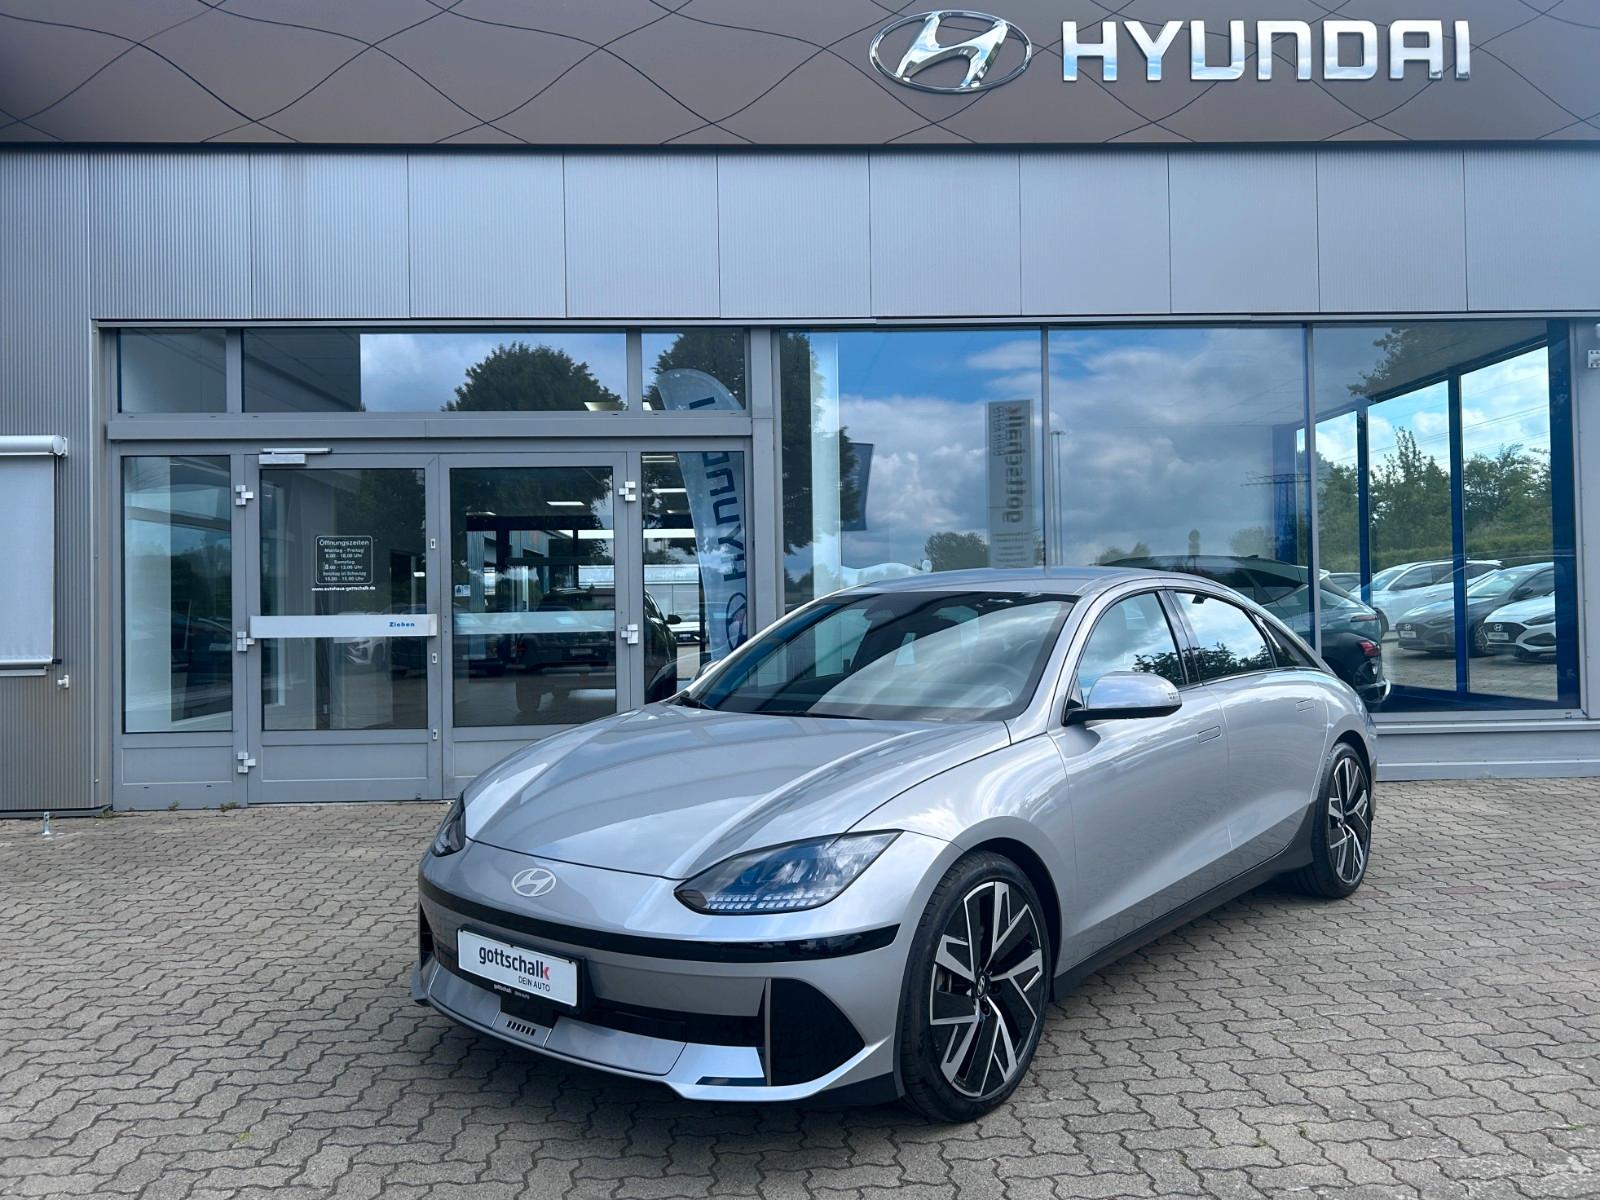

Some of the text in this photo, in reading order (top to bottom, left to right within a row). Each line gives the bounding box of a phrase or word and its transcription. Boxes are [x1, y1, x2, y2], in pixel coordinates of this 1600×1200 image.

[1062, 19, 1471, 81] HYUNDAI
[319, 539, 370, 547] Öffnungszeiten
[479, 946, 550, 981] gottschalk
[518, 975, 550, 992] DEIN AUTO
